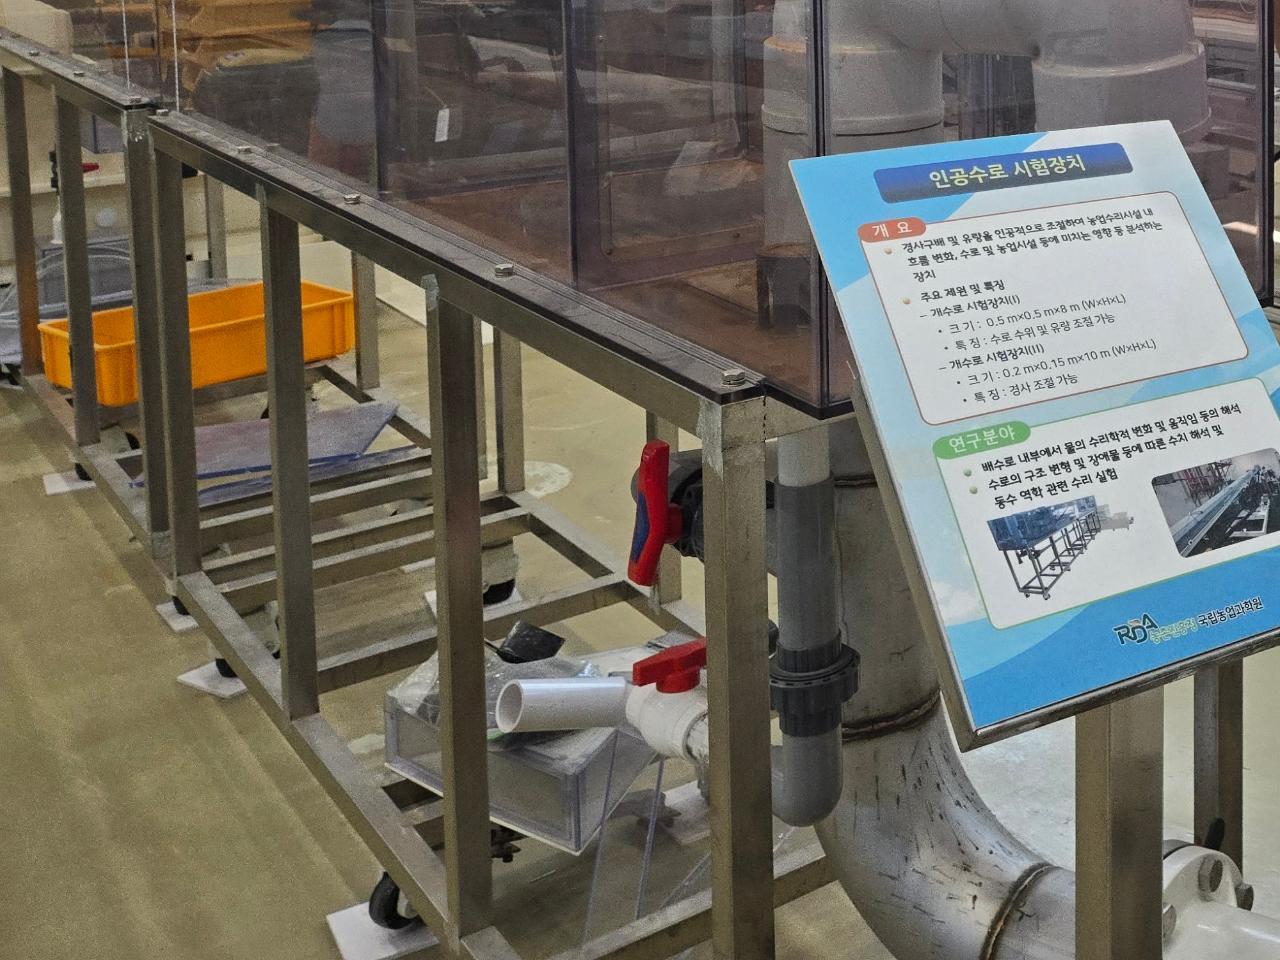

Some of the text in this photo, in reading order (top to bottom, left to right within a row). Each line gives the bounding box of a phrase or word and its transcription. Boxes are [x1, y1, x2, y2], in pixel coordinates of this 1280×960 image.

[929, 153, 1086, 189] 인공수로 시험장치
[902, 207, 1153, 253] 경사구배 및 유량을 인공적으로 조절하여 농업수리시설 내
[907, 255, 930, 267] 흐름
[960, 247, 981, 259] 수로
[982, 245, 995, 256] 및
[997, 239, 1038, 254] 농업시설
[1039, 234, 1059, 248] 등에
[1060, 231, 1091, 242] 미치는
[1092, 227, 1113, 240] 영향
[1114, 226, 1125, 236] 등
[1125, 221, 1163, 234] 분석하는
[913, 269, 936, 282] 장치
[921, 279, 1005, 303] 주요 제원 및 특징
[930, 304, 965, 318] 개수로
[986, 315, 1005, 327] 0.5
[990, 331, 1013, 345] 수로
[1014, 326, 1036, 340] 수위
[1037, 324, 1049, 336] 및
[1050, 321, 1071, 333] 유량
[1073, 315, 1094, 329] 조절
[1094, 312, 1115, 325] 가능
[949, 355, 984, 369] 개수로
[1002, 366, 1021, 378] 0.2
[1009, 381, 1031, 397] 경사
[1033, 376, 1056, 390] 조절
[1056, 373, 1078, 385] 가능
[949, 424, 1016, 454] 연구분야
[981, 403, 1242, 472] 배수로 내부에서 물의 수리학적 변화 및 움직임 등의 해석
[988, 424, 1224, 491] 수로의 구조 변형 및 장애물 등에 따른 수치 해석 및
[994, 467, 1119, 510] 동수 역학 관련 수리 실험
[1113, 613, 1159, 645] RDA
[1198, 596, 1264, 627] 국립농업과학원
